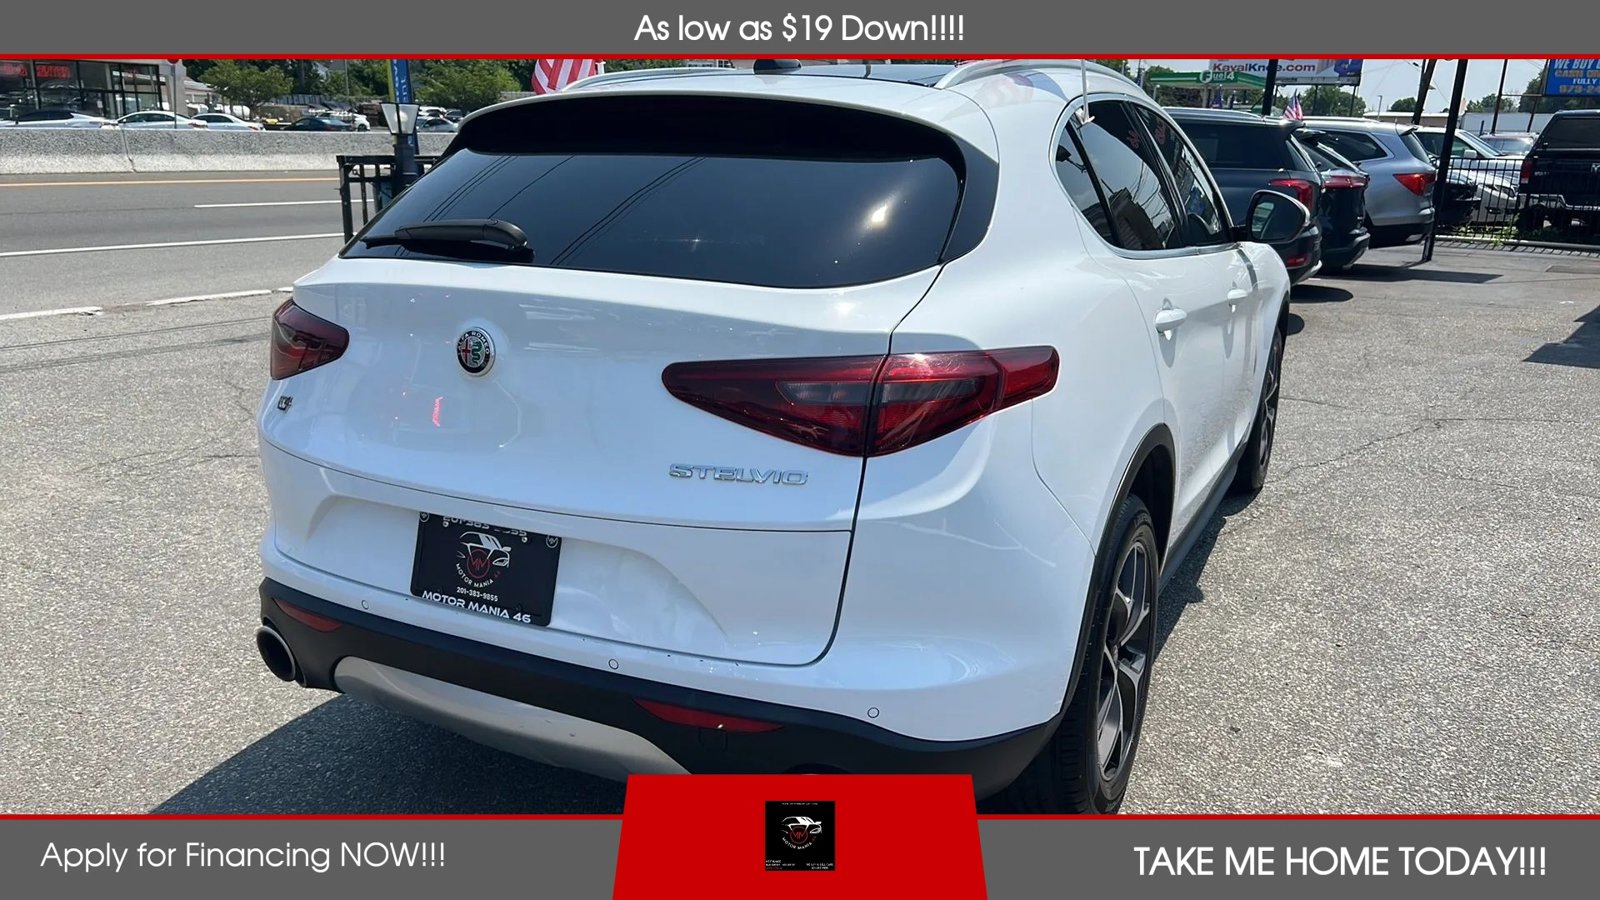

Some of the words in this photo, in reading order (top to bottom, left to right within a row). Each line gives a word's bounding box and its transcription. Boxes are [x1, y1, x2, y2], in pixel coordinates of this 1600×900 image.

[1572, 59, 1594, 69] BUY
[471, 331, 490, 354] ROMEO
[669, 463, 809, 486] STELVIO
[456, 563, 473, 585] MOTOR
[473, 578, 494, 588] MANIA
[456, 586, 499, 602] 201-383-9855
[422, 590, 466, 608] MOTOR
[468, 601, 510, 619] MANIA
[512, 612, 532, 624] 46
